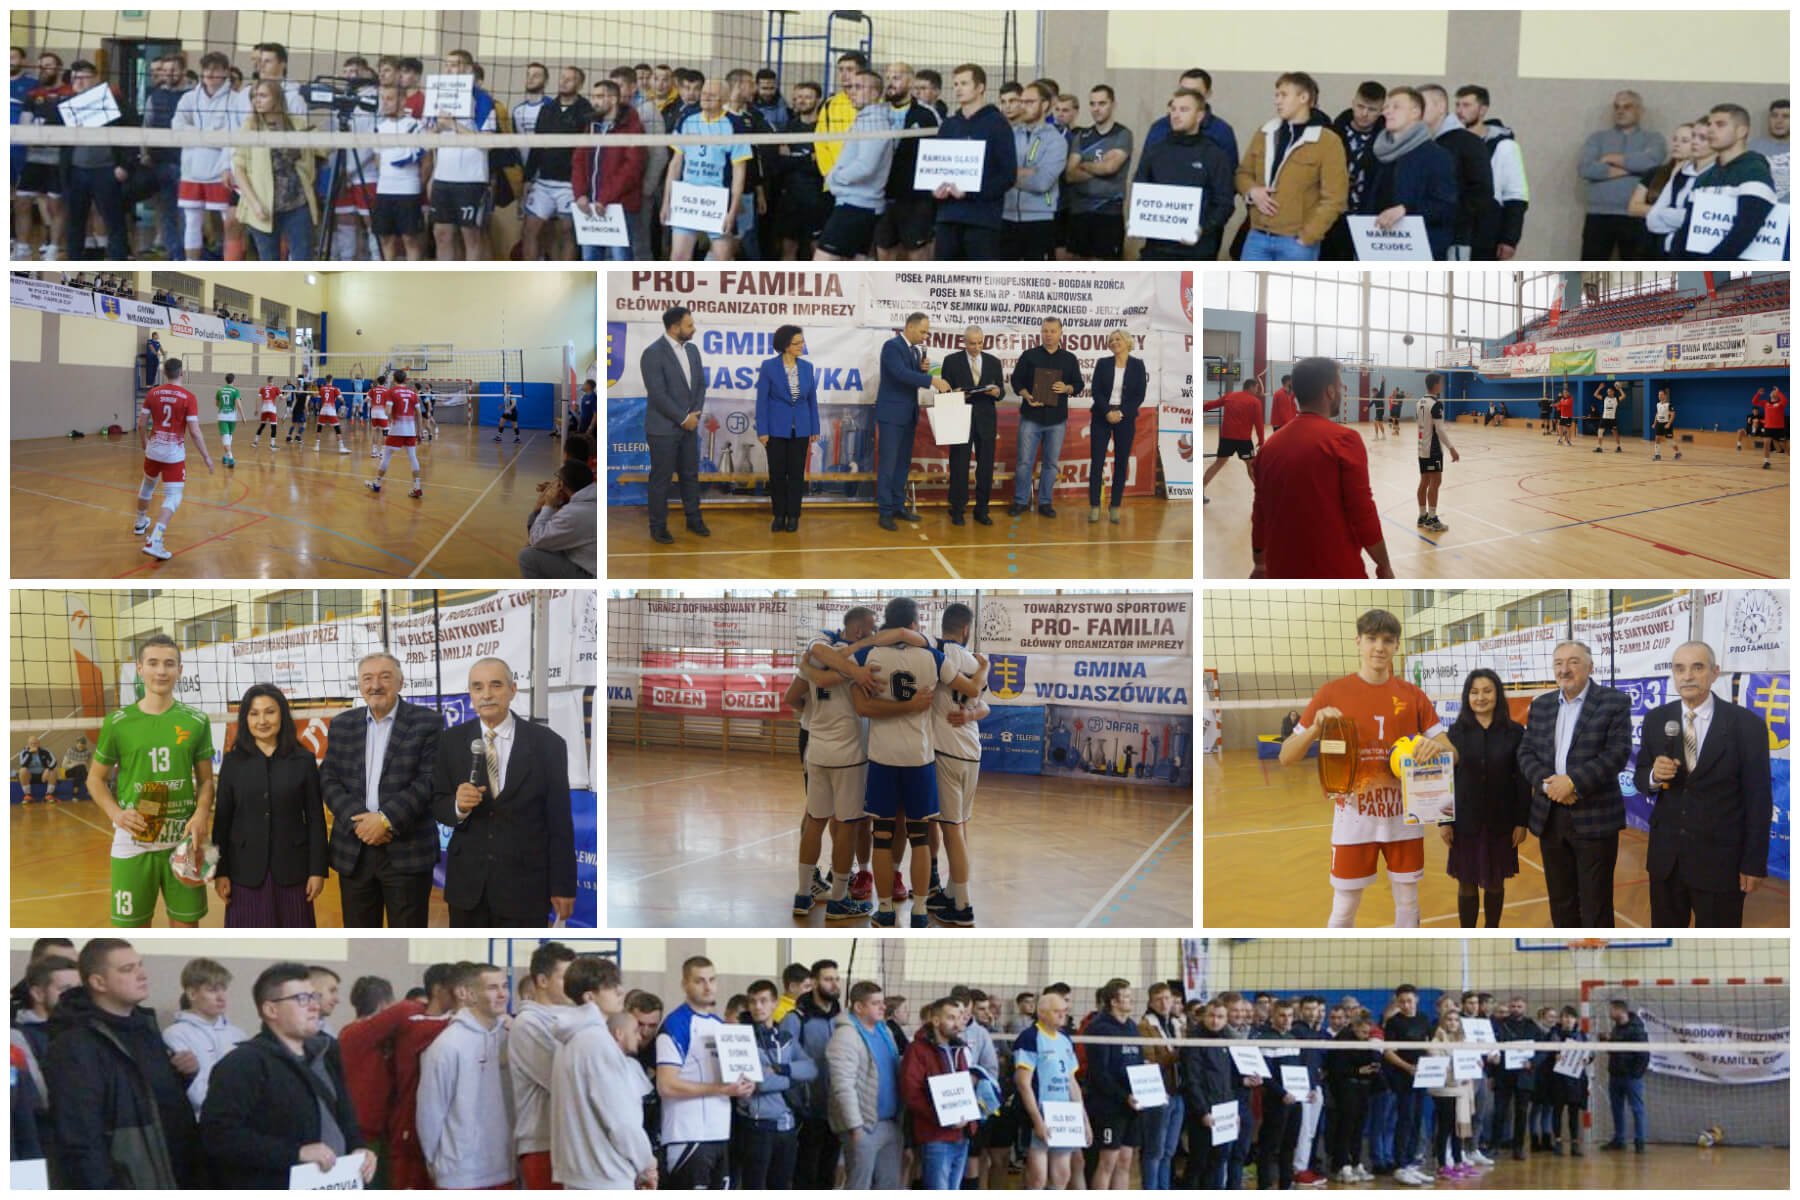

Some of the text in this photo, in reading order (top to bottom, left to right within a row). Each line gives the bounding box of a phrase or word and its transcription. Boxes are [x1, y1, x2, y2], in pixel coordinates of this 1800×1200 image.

[631, 271, 843, 297] PRO- FAMILIA
[895, 273, 922, 283] POSEŁ
[925, 274, 982, 285] PARLAMENTU
[1059, 279, 1092, 288] BOGDAN
[930, 287, 957, 297] POSEŁ
[960, 289, 971, 298] NA
[1019, 290, 1044, 300] MARIA
[1047, 292, 1093, 301] KUROWSKA
[616, 295, 856, 316] GŁÓWNY ORGANIZATOR IMPREZY
[950, 302, 988, 311] SEJMIKU
[990, 303, 1011, 312] WOJ.
[1014, 304, 1087, 314] PODKARPACKIEGO
[968, 315, 1042, 325] PODKARPACKIEGO
[1104, 318, 1129, 327] ORTYL
[402, 398, 410, 413] 7
[162, 404, 173, 427] 2
[648, 602, 788, 614] TURNIEJ DOFINANSOWANY PRZEZ
[1023, 602, 1187, 613] TOWARZYSTWO SPORTOWE
[438, 618, 504, 642] SIATKOWEJ
[1031, 618, 1175, 636] PRO- FAMILIA
[1625, 620, 1675, 639] SIATKOWEJ
[476, 640, 500, 656] CUP
[1020, 637, 1184, 649] GŁÓWNY ORGANIZATOR IMPREZY
[1652, 637, 1671, 649] CUP
[1074, 661, 1147, 678] GMINA
[891, 671, 917, 700] 6
[1035, 682, 1188, 705] WOJASZÓWKA
[655, 690, 776, 709] ORLEN ORLEN
[1644, 680, 1661, 710] 3
[1105, 720, 1140, 733] JAFAR
[1374, 715, 1385, 740] 7
[148, 747, 171, 773] 13
[114, 889, 133, 916] 13
[1104, 1128, 1112, 1144] 9
